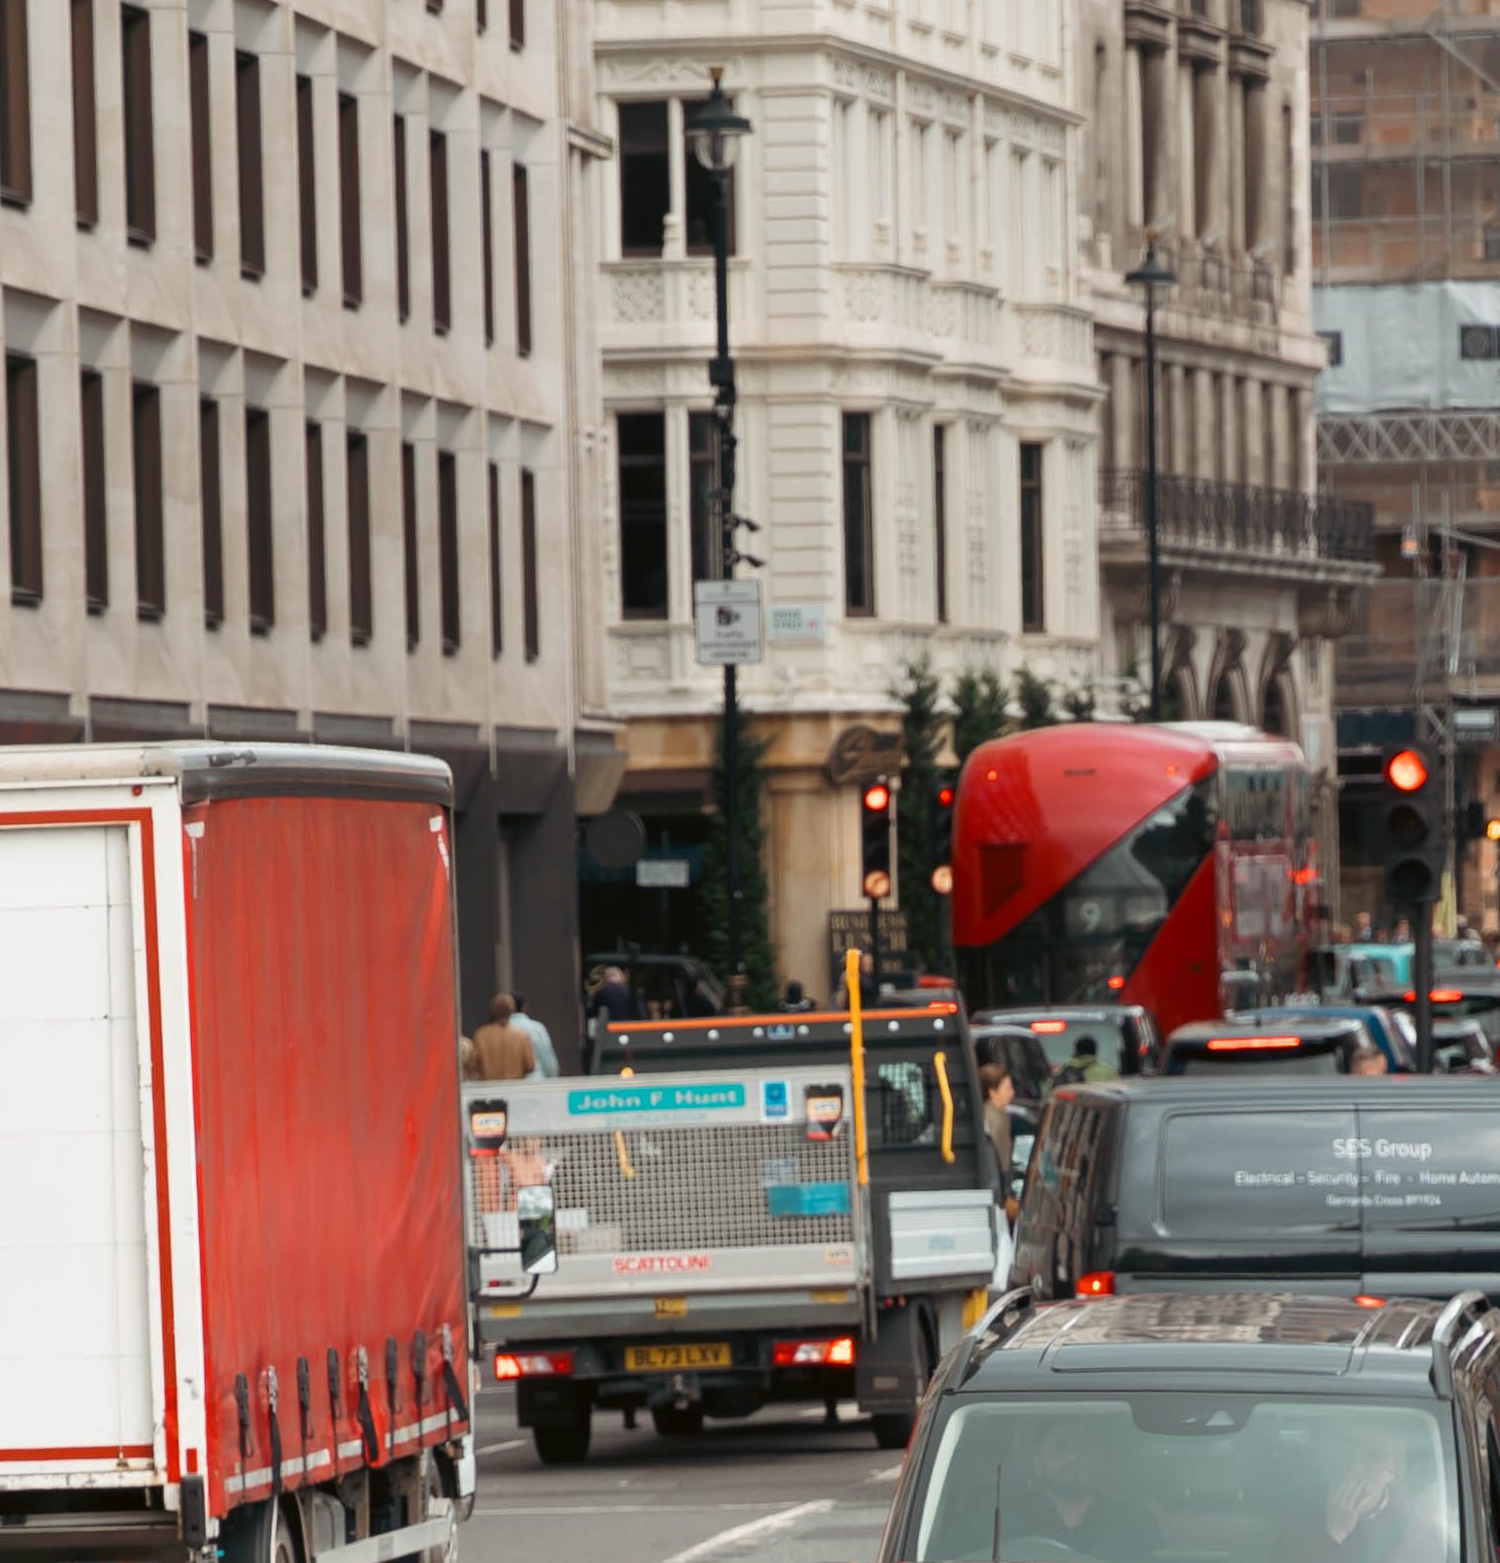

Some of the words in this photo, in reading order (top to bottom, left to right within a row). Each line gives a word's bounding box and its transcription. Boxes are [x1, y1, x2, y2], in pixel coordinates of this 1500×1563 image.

[577, 1092, 641, 1111] John
[650, 1091, 664, 1107] F
[674, 1087, 738, 1105] Hunt
[1332, 1138, 1372, 1159] SES
[1374, 1138, 1433, 1162] Group
[1234, 1170, 1296, 1187] Electrical
[1307, 1170, 1360, 1188] Security
[1374, 1170, 1401, 1185] Fire
[1419, 1170, 1457, 1185] Home
[612, 1254, 712, 1275] SCATTOLINI
[633, 1345, 682, 1367] BL73
[686, 1344, 724, 1366] LXV
